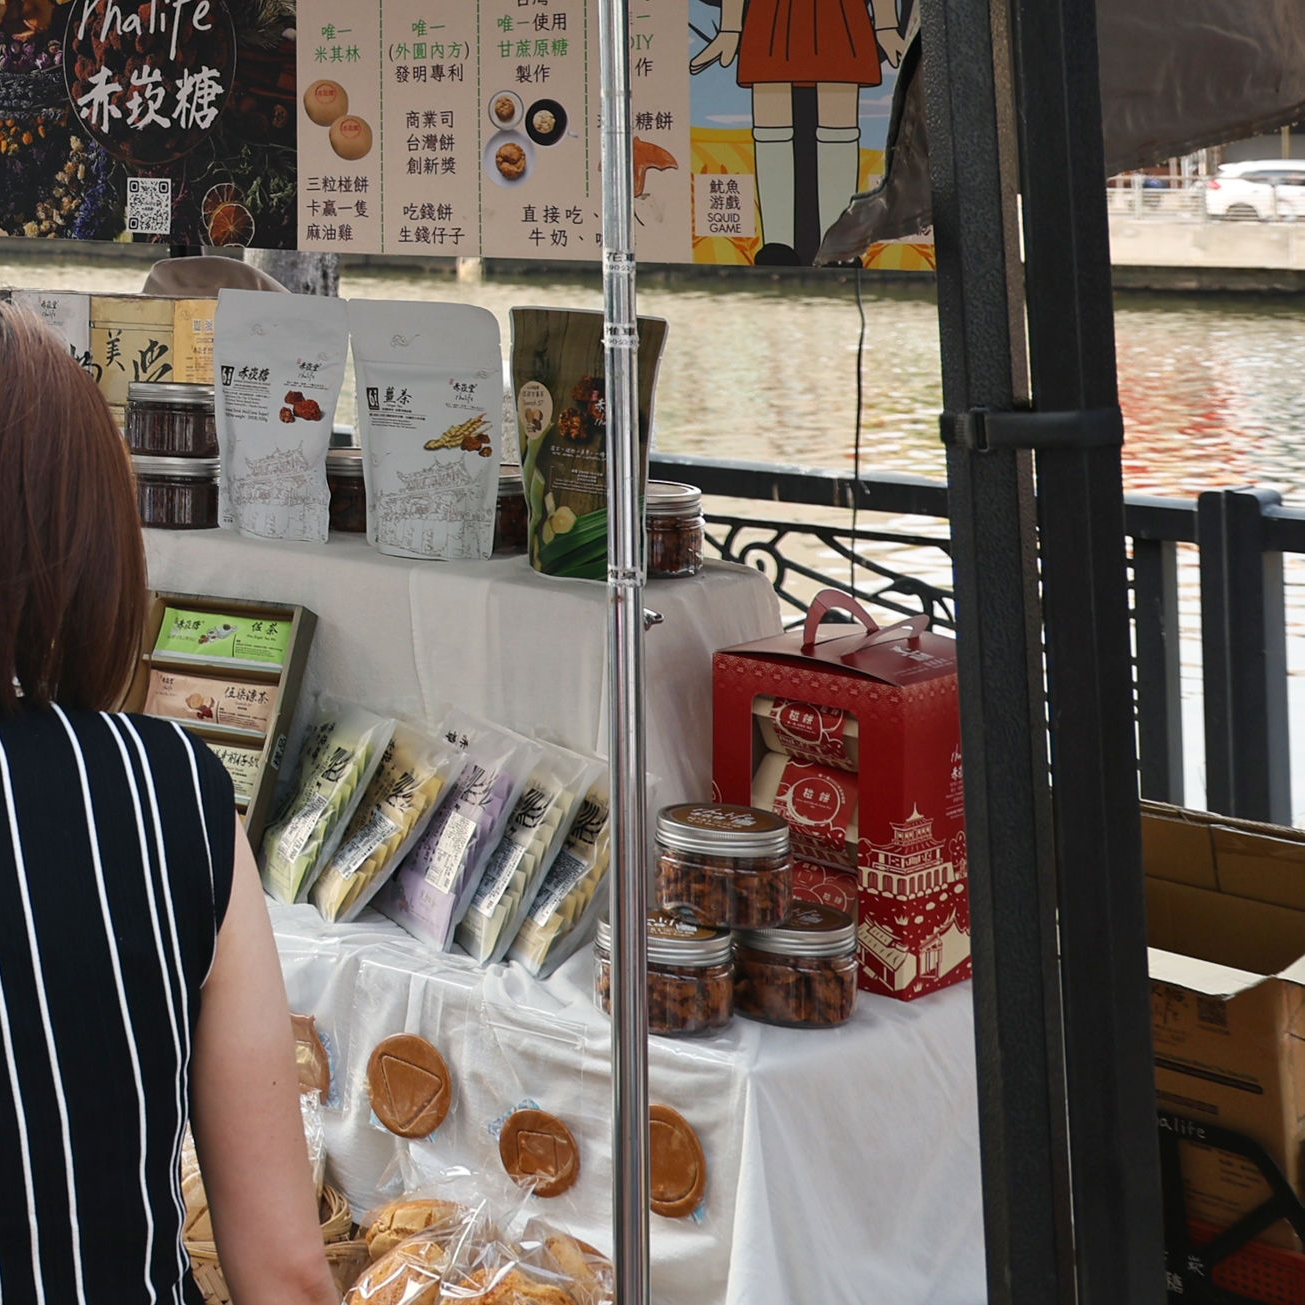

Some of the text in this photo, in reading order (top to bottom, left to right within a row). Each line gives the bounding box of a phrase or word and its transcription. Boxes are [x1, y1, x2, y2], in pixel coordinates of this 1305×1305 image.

[497, 13, 567, 33] 唯一使用
[630, 11, 650, 25] 一
[321, 23, 352, 41] 唯一
[411, 19, 445, 37] 唯一
[314, 45, 361, 63] 米其林
[497, 38, 569, 58] 甘蔗原糖
[394, 63, 464, 83] 發明專利
[515, 64, 551, 83] 製作
[634, 57, 654, 77] 作
[79, 65, 225, 133] 赤崁糖
[405, 110, 454, 129] 商業司
[597, 111, 674, 131] 糖餅
[406, 134, 455, 152] 台灣餅
[406, 157, 456, 175] 創新獎
[306, 176, 369, 193] 三粒椪餅
[709, 180, 740, 195] 魷魚
[403, 203, 453, 222] 吃錢餅
[707, 212, 740, 223] SQUID
[306, 223, 353, 241] 麻油雞
[398, 227, 465, 245] 生錢仔子
[709, 223, 741, 234] GAME
[383, 386, 412, 405] 薑茶
[803, 788, 830, 803] 椪餅
[1158, 1117, 1205, 1139] alife
